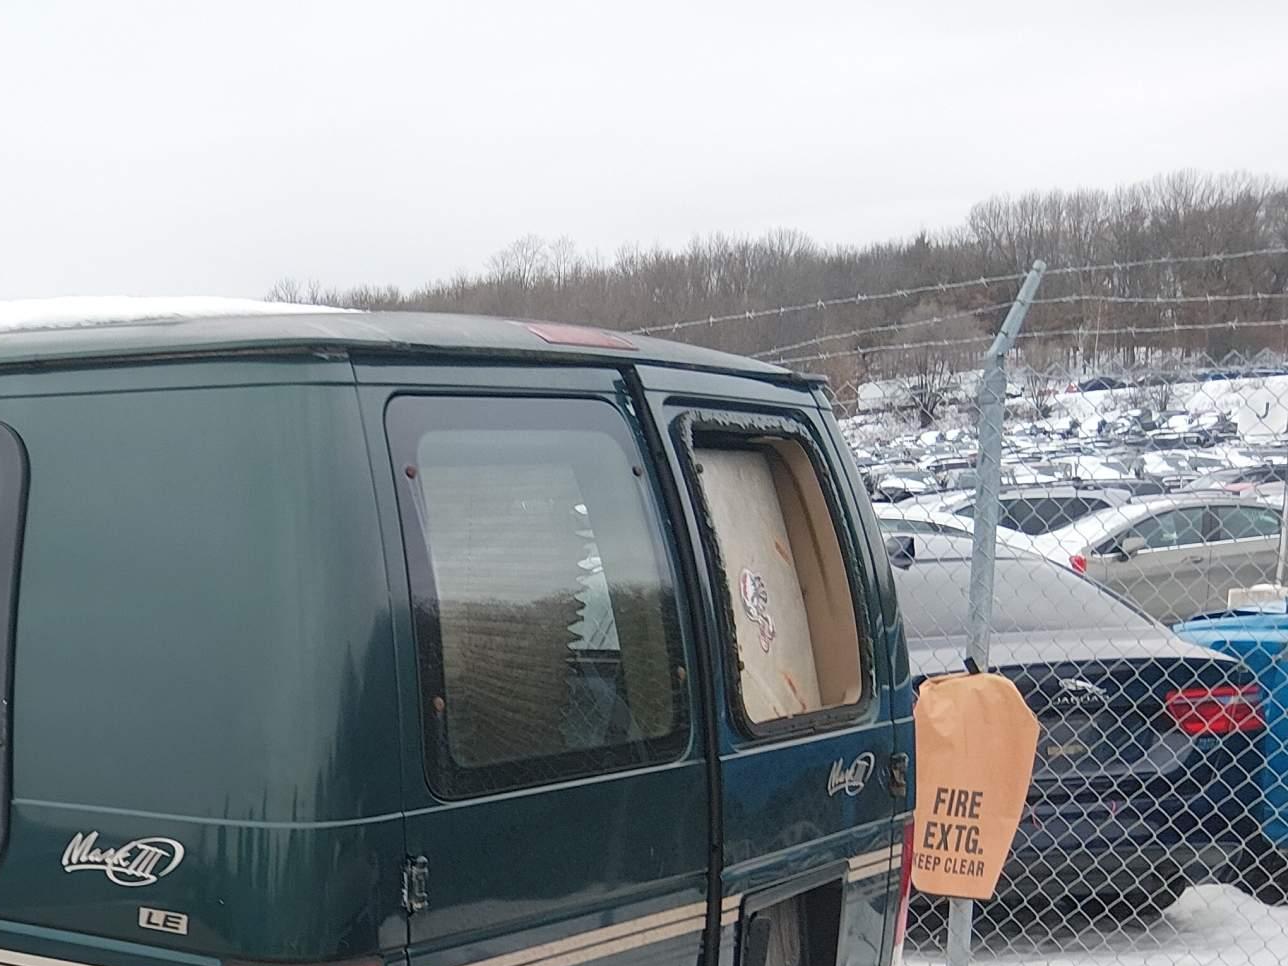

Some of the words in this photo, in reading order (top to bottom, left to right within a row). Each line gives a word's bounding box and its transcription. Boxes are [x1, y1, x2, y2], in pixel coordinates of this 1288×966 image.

[932, 787, 983, 819] FIRE
[62, 831, 132, 872] Mark
[923, 821, 983, 855] EXTG.
[944, 857, 985, 877] CLEAR
[146, 911, 183, 930] LE
